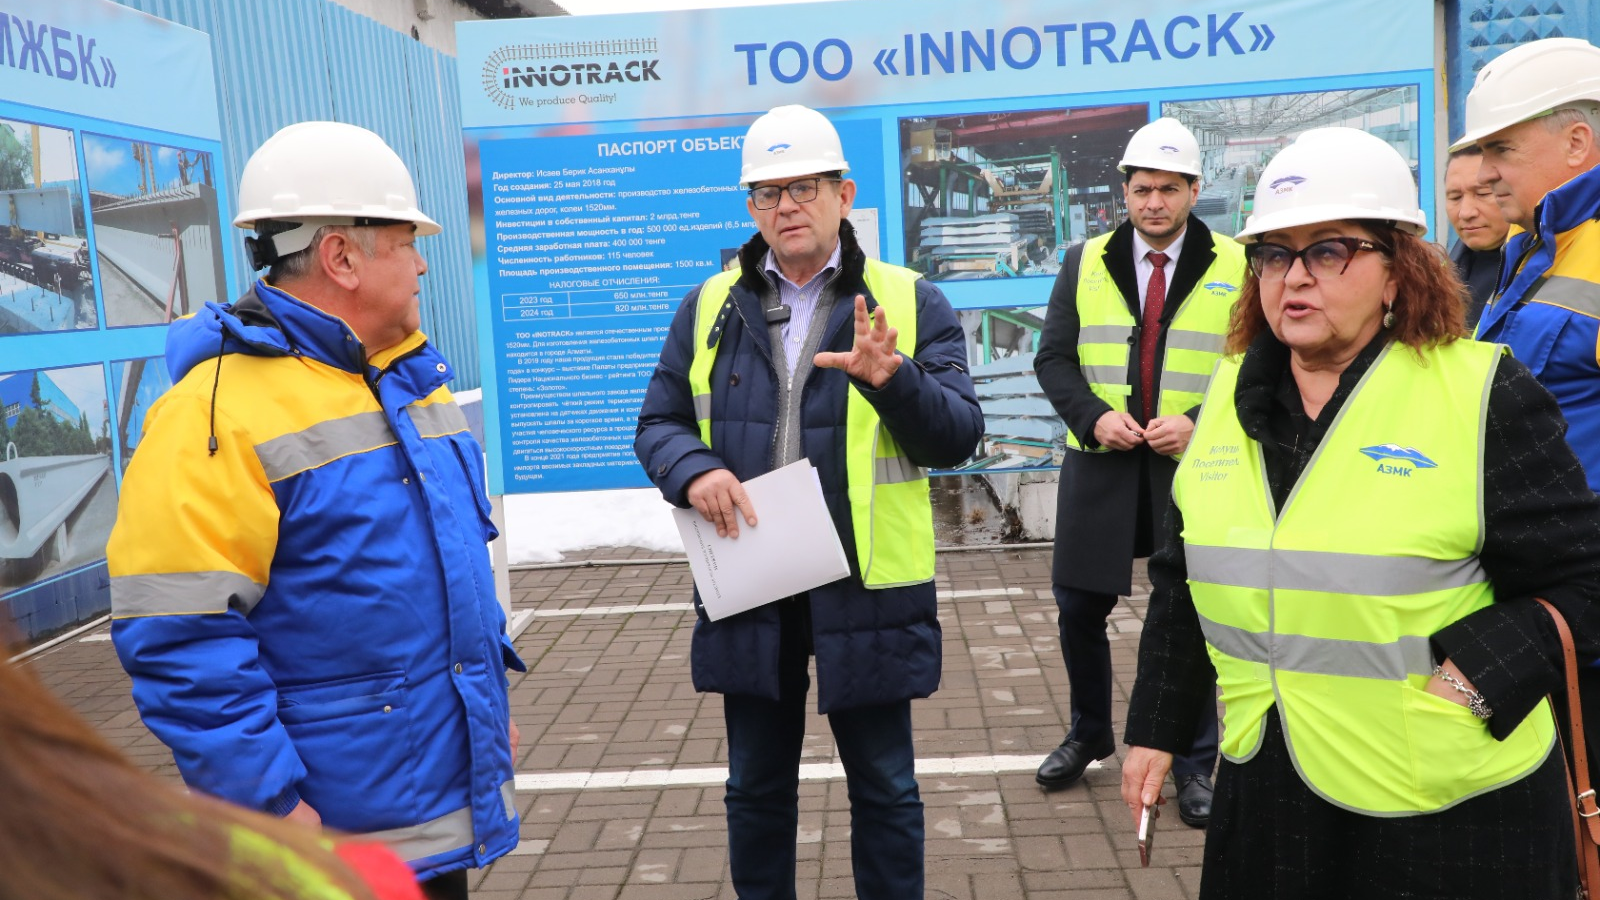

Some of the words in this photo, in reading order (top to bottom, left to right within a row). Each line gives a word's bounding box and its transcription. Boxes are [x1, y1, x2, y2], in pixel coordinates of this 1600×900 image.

[734, 38, 853, 86] ТОО
[872, 11, 1276, 76] «INNOTRACK»
[519, 97, 534, 106] We
[537, 96, 575, 107] produce
[578, 93, 617, 104] Quality!
[598, 139, 676, 157] ПАСПОРТ
[492, 171, 534, 180] Директор:
[562, 168, 586, 176] Берик
[494, 184, 508, 192] Год
[510, 182, 551, 190] создания:
[583, 179, 601, 187] 2018
[495, 196, 536, 204] Основной
[556, 192, 616, 202] деятельности:
[618, 188, 671, 198] производство
[673, 185, 737, 194] железобетонных
[495, 208, 533, 216] железных
[535, 206, 558, 215] дорог,
[561, 205, 583, 213] колеи
[586, 203, 616, 212] 1520мм.
[496, 220, 545, 228] Инвестиции
[555, 216, 610, 226] собственный
[612, 215, 648, 223] капитал:
[497, 230, 574, 241] Производственная
[577, 228, 618, 237] мощность
[647, 225, 660, 233] 500
[725, 221, 739, 230] (6,5
[497, 245, 533, 254] Средняя
[535, 241, 582, 251] заработная
[584, 240, 610, 248] плата:
[612, 239, 626, 247] 400
[498, 256, 552, 265] Численность
[555, 253, 605, 263] работников:
[623, 250, 653, 258] человек
[499, 269, 537, 277] Площадь
[540, 264, 620, 275] производственного
[623, 261, 673, 271] помещения:
[675, 260, 693, 268] 1500
[549, 279, 600, 289] НАЛОГОВЫЕ
[602, 276, 660, 287] ОТЧИСЛЕНИЯ:
[520, 296, 538, 304] 2023
[614, 292, 628, 300] 650
[520, 309, 538, 317] 2024
[541, 309, 553, 317] год
[615, 304, 629, 312] 820
[1377, 463, 1412, 478] АЗМК
